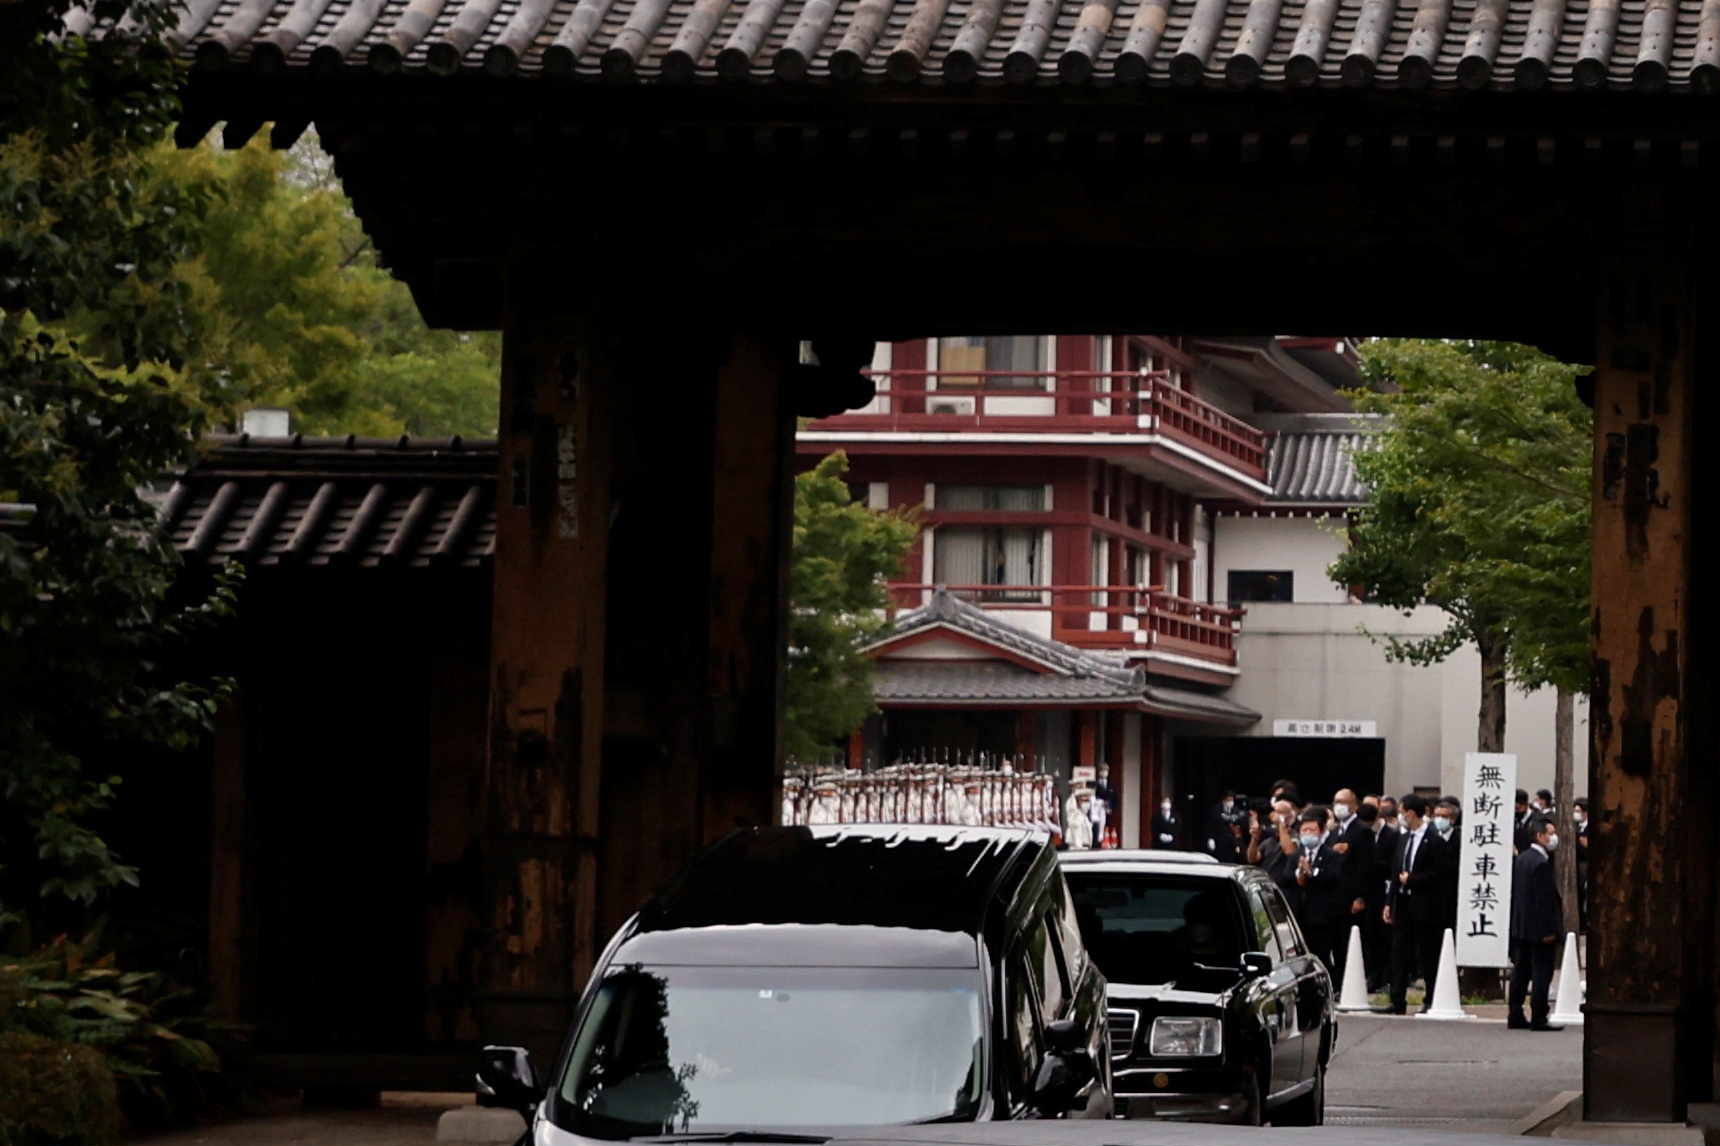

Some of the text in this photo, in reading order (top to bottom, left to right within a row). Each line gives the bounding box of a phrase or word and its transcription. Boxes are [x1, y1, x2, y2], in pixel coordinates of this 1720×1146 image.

[1466, 764, 1506, 938] 無断駐車禁止
